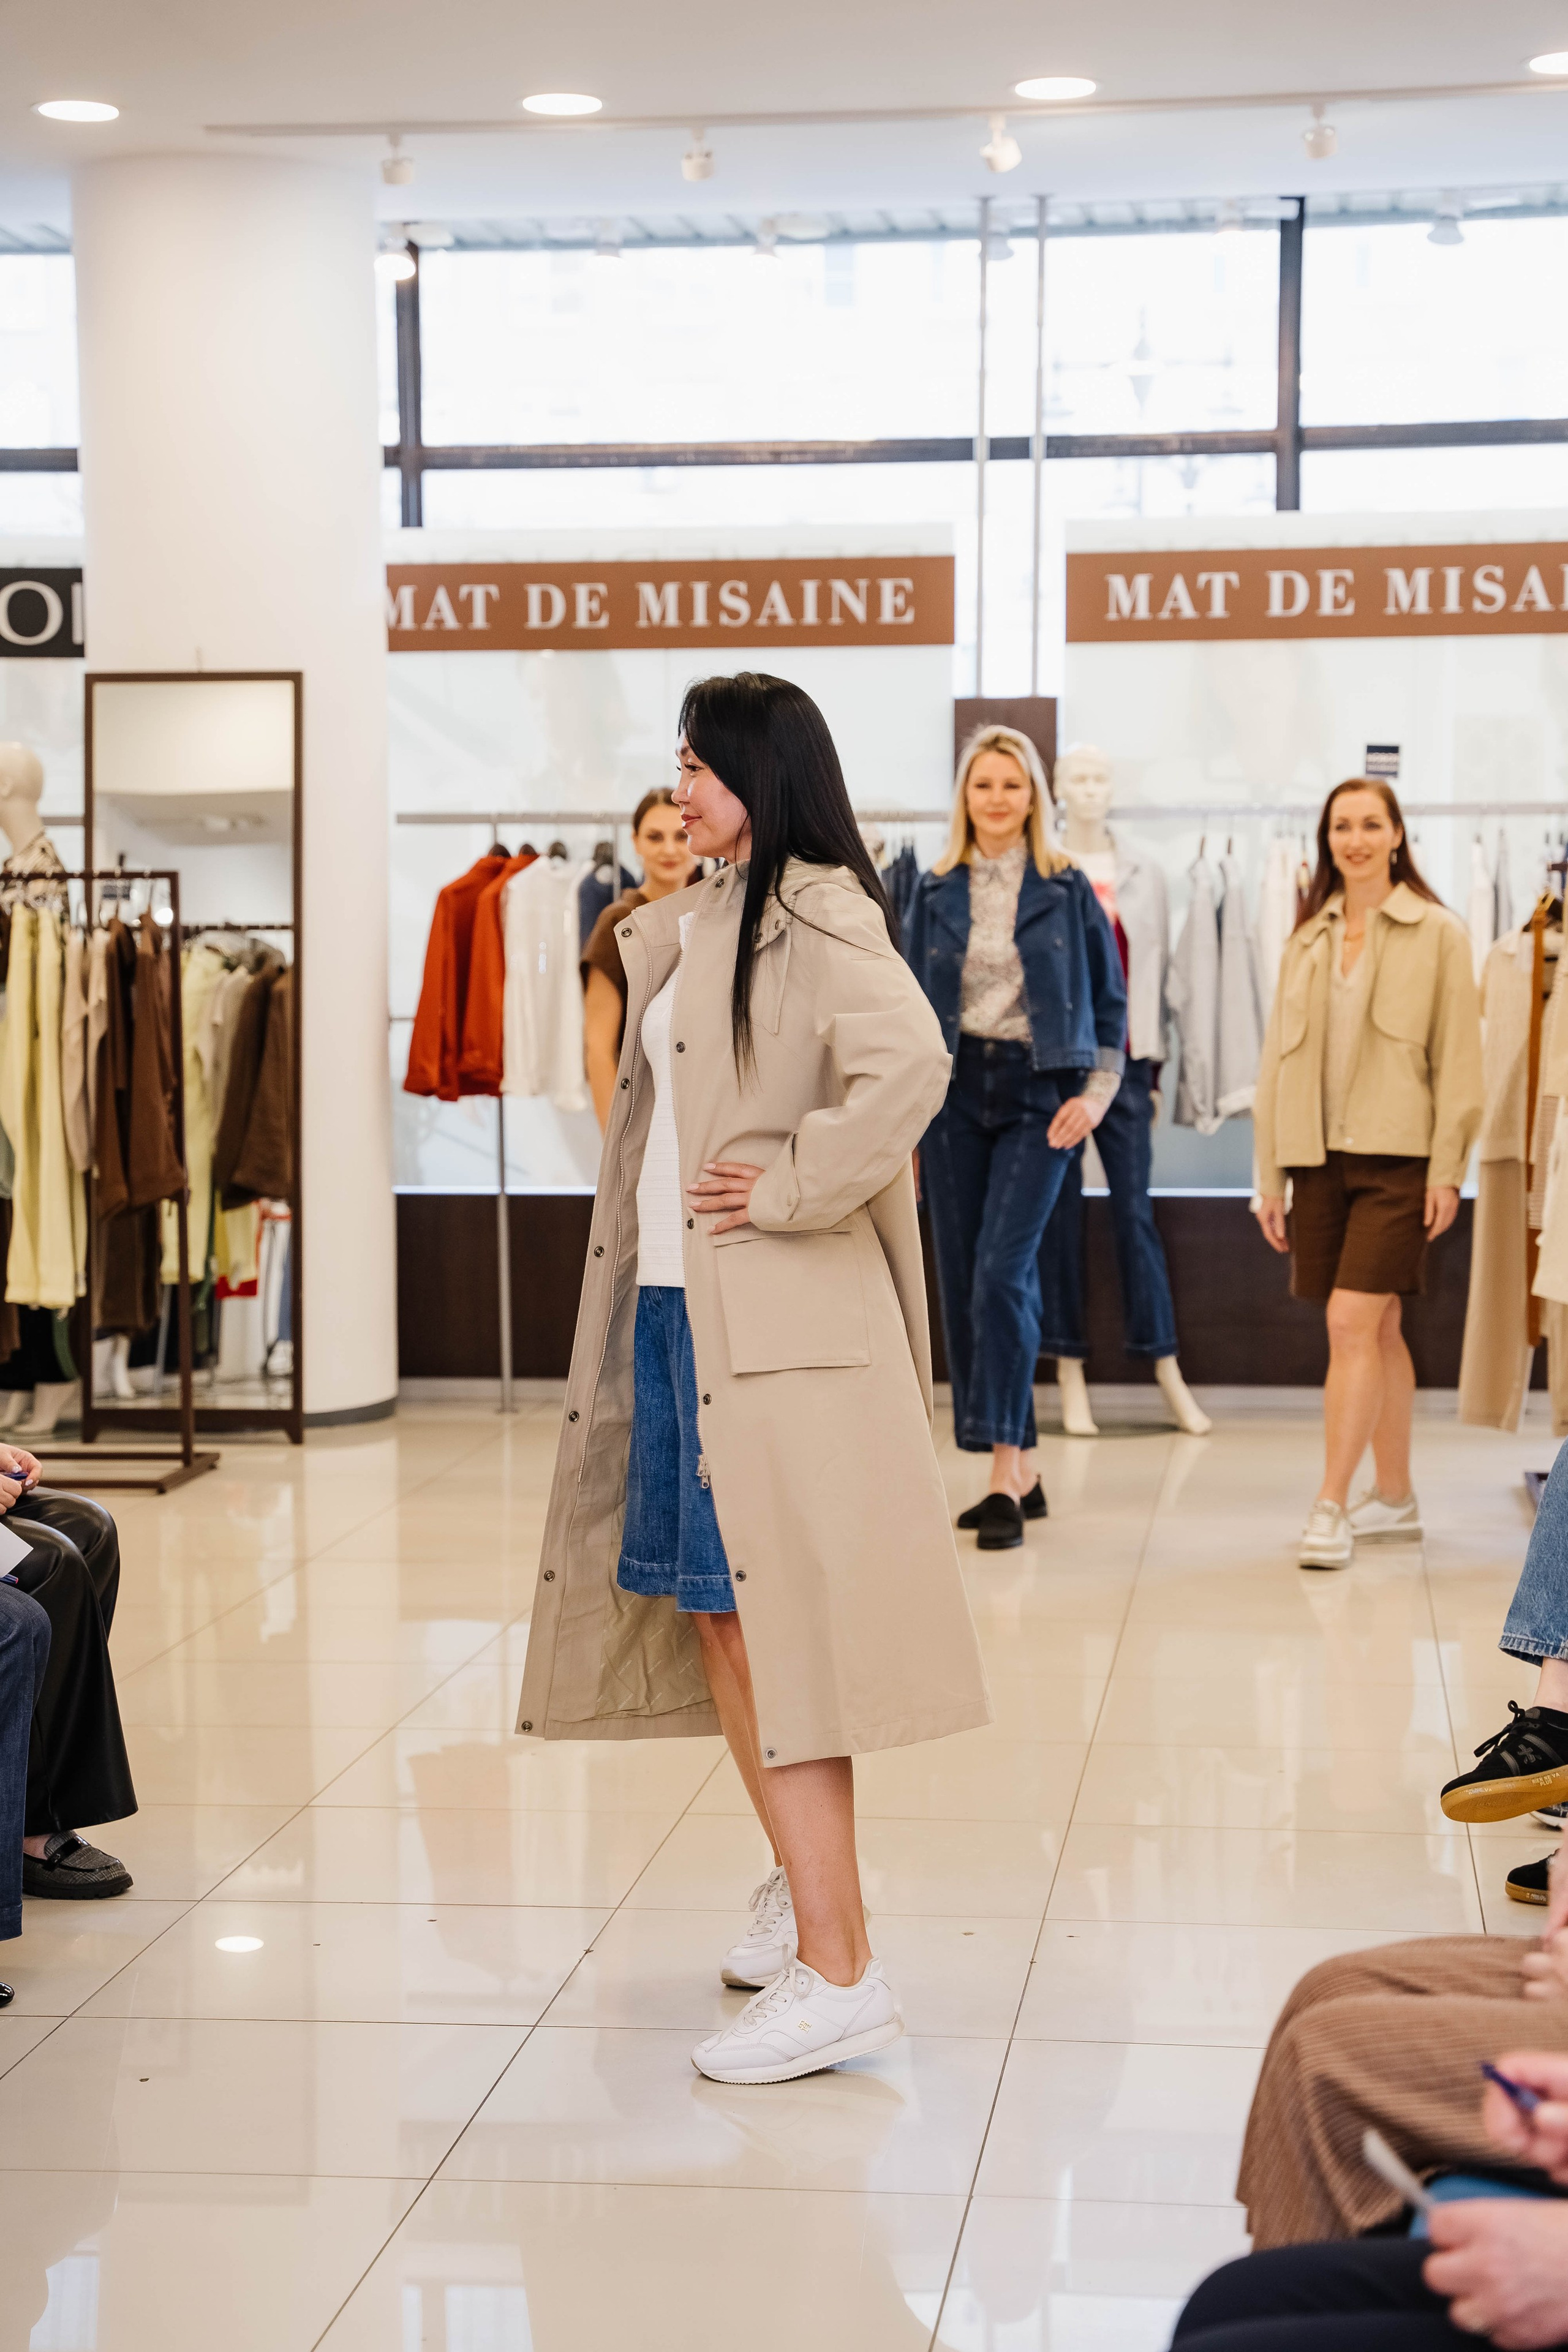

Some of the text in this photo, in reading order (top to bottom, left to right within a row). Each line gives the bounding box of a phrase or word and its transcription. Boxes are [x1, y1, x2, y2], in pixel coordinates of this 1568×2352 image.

[387, 578, 915, 630] MAT DE MISAINE
[1105, 571, 1240, 620] MAT
[1265, 569, 1356, 618] DE
